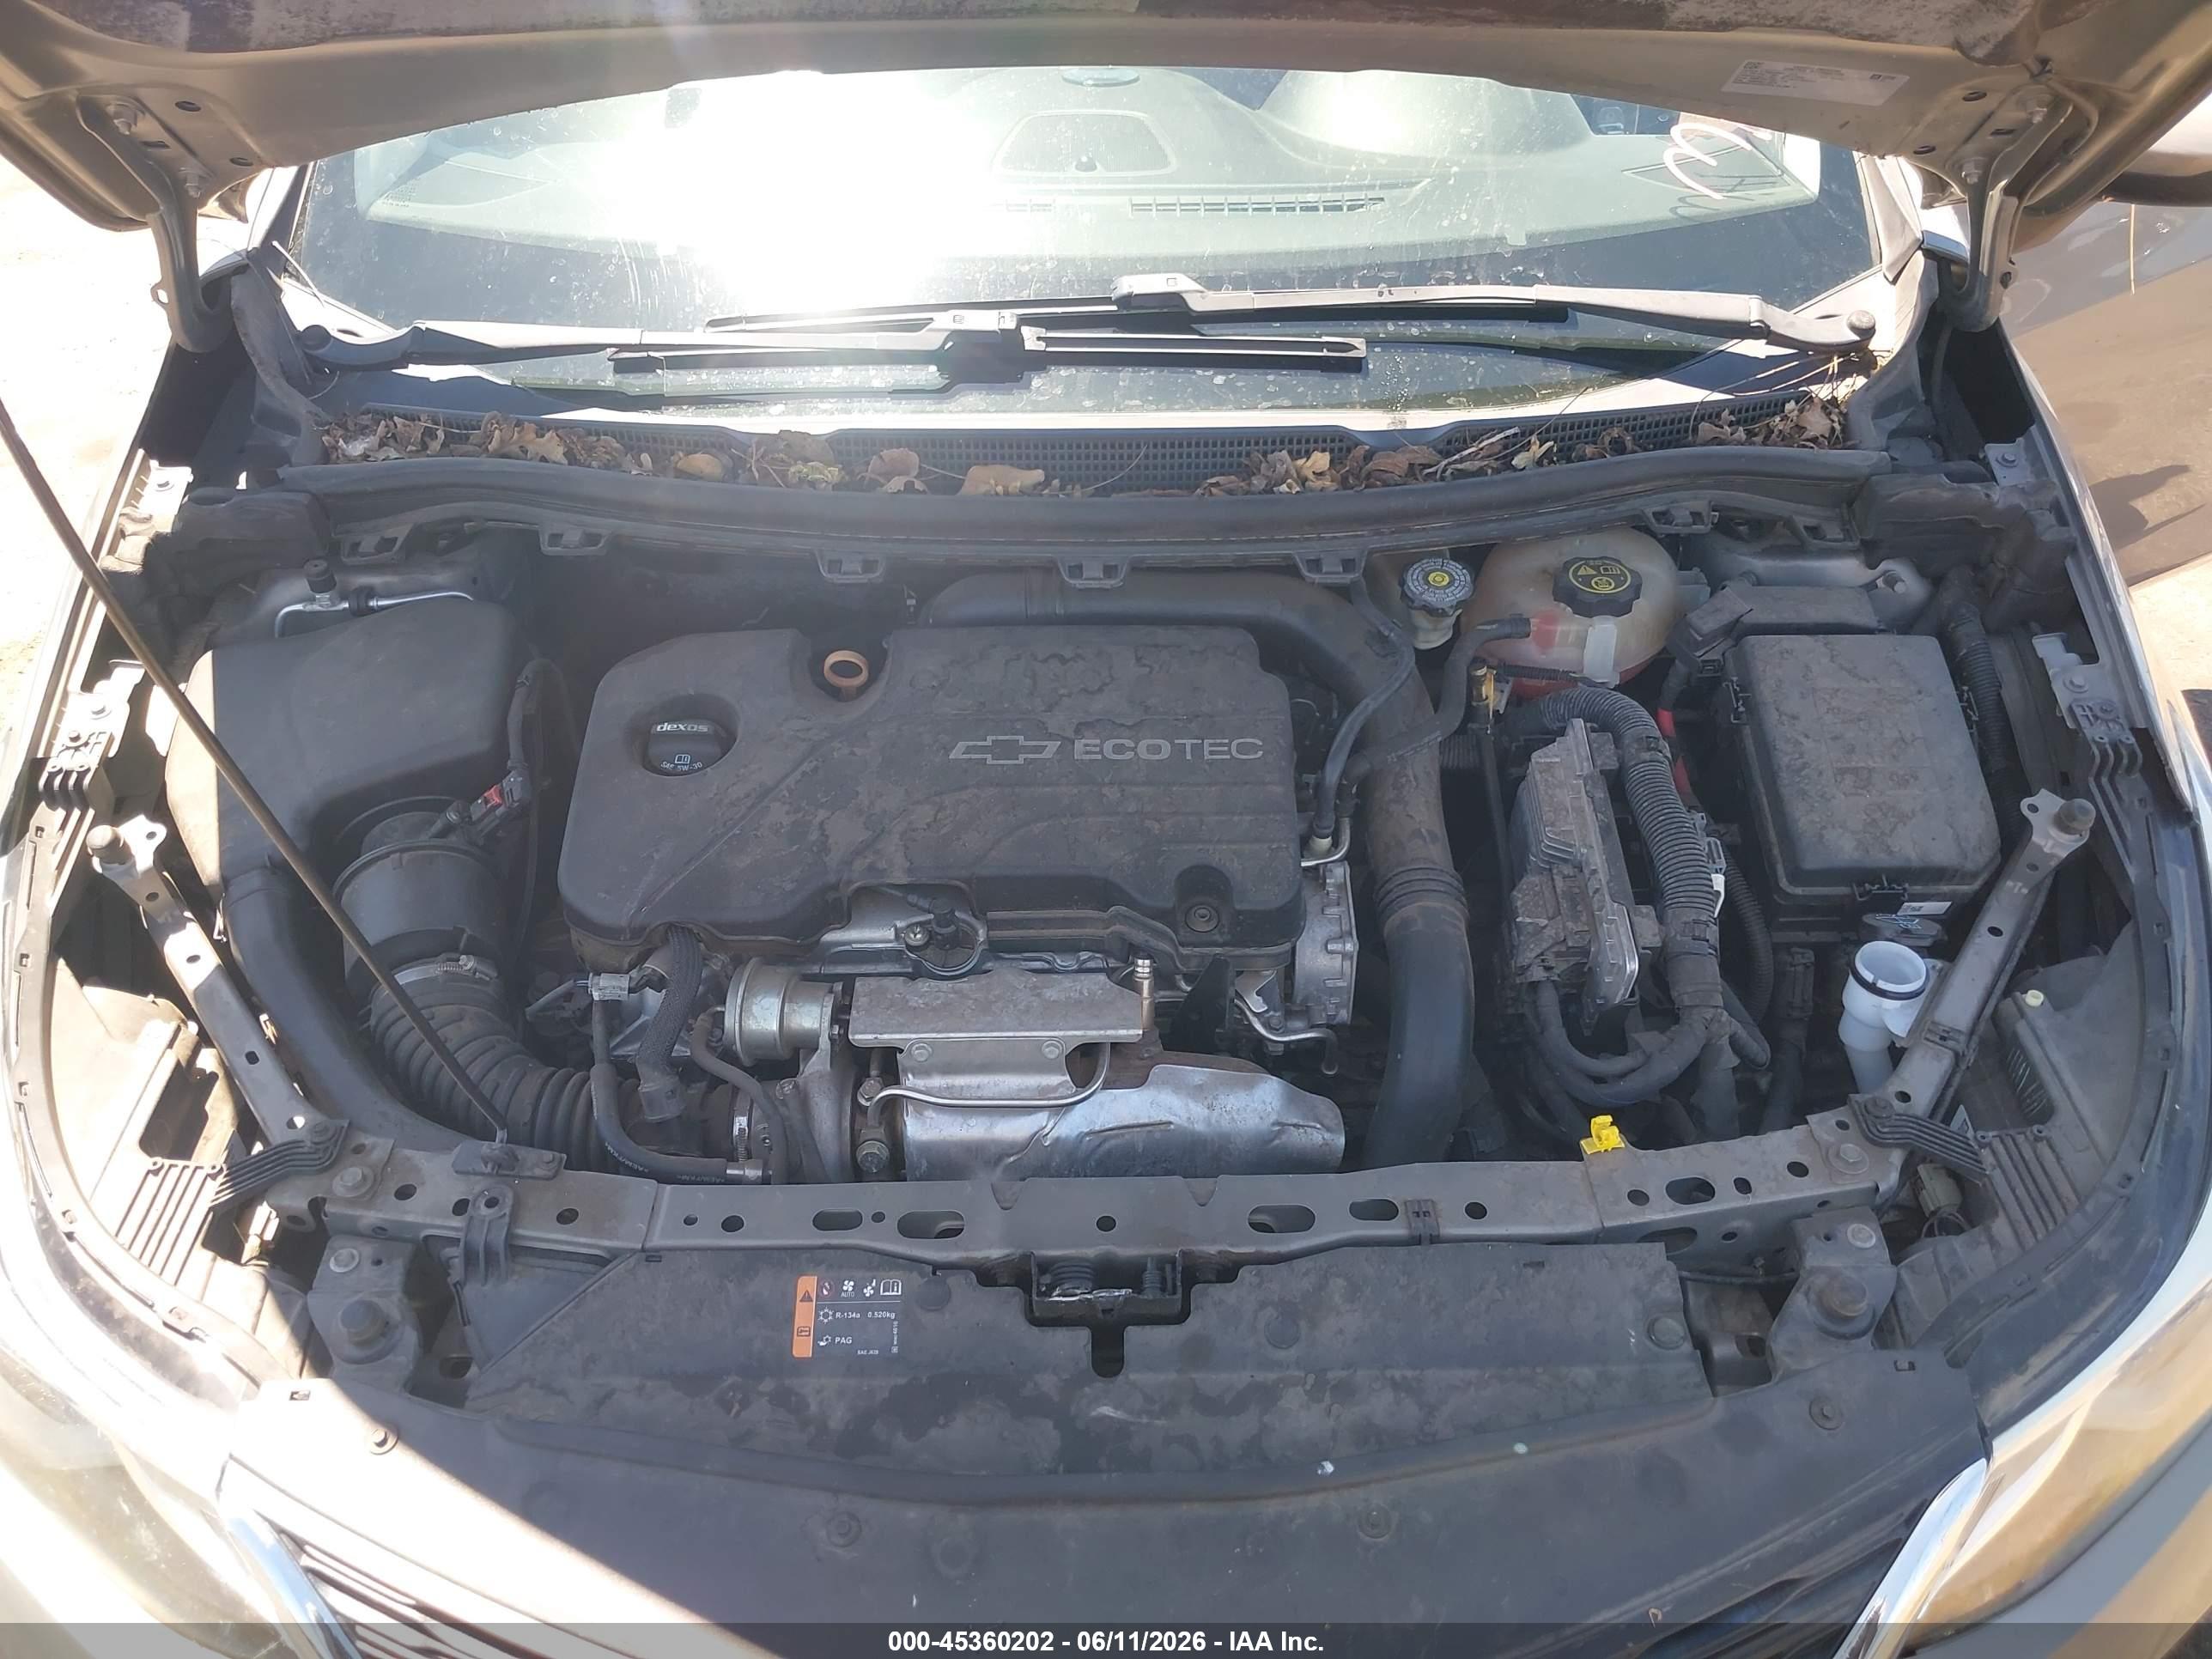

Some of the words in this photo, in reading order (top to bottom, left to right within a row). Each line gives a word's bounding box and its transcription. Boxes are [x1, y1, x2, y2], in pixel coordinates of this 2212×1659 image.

[657, 722, 708, 732] dexos
[1074, 738, 1263, 760] ECOTEC
[678, 762, 702, 771] 5W-30
[867, 1311, 896, 1320] 0.520kg
